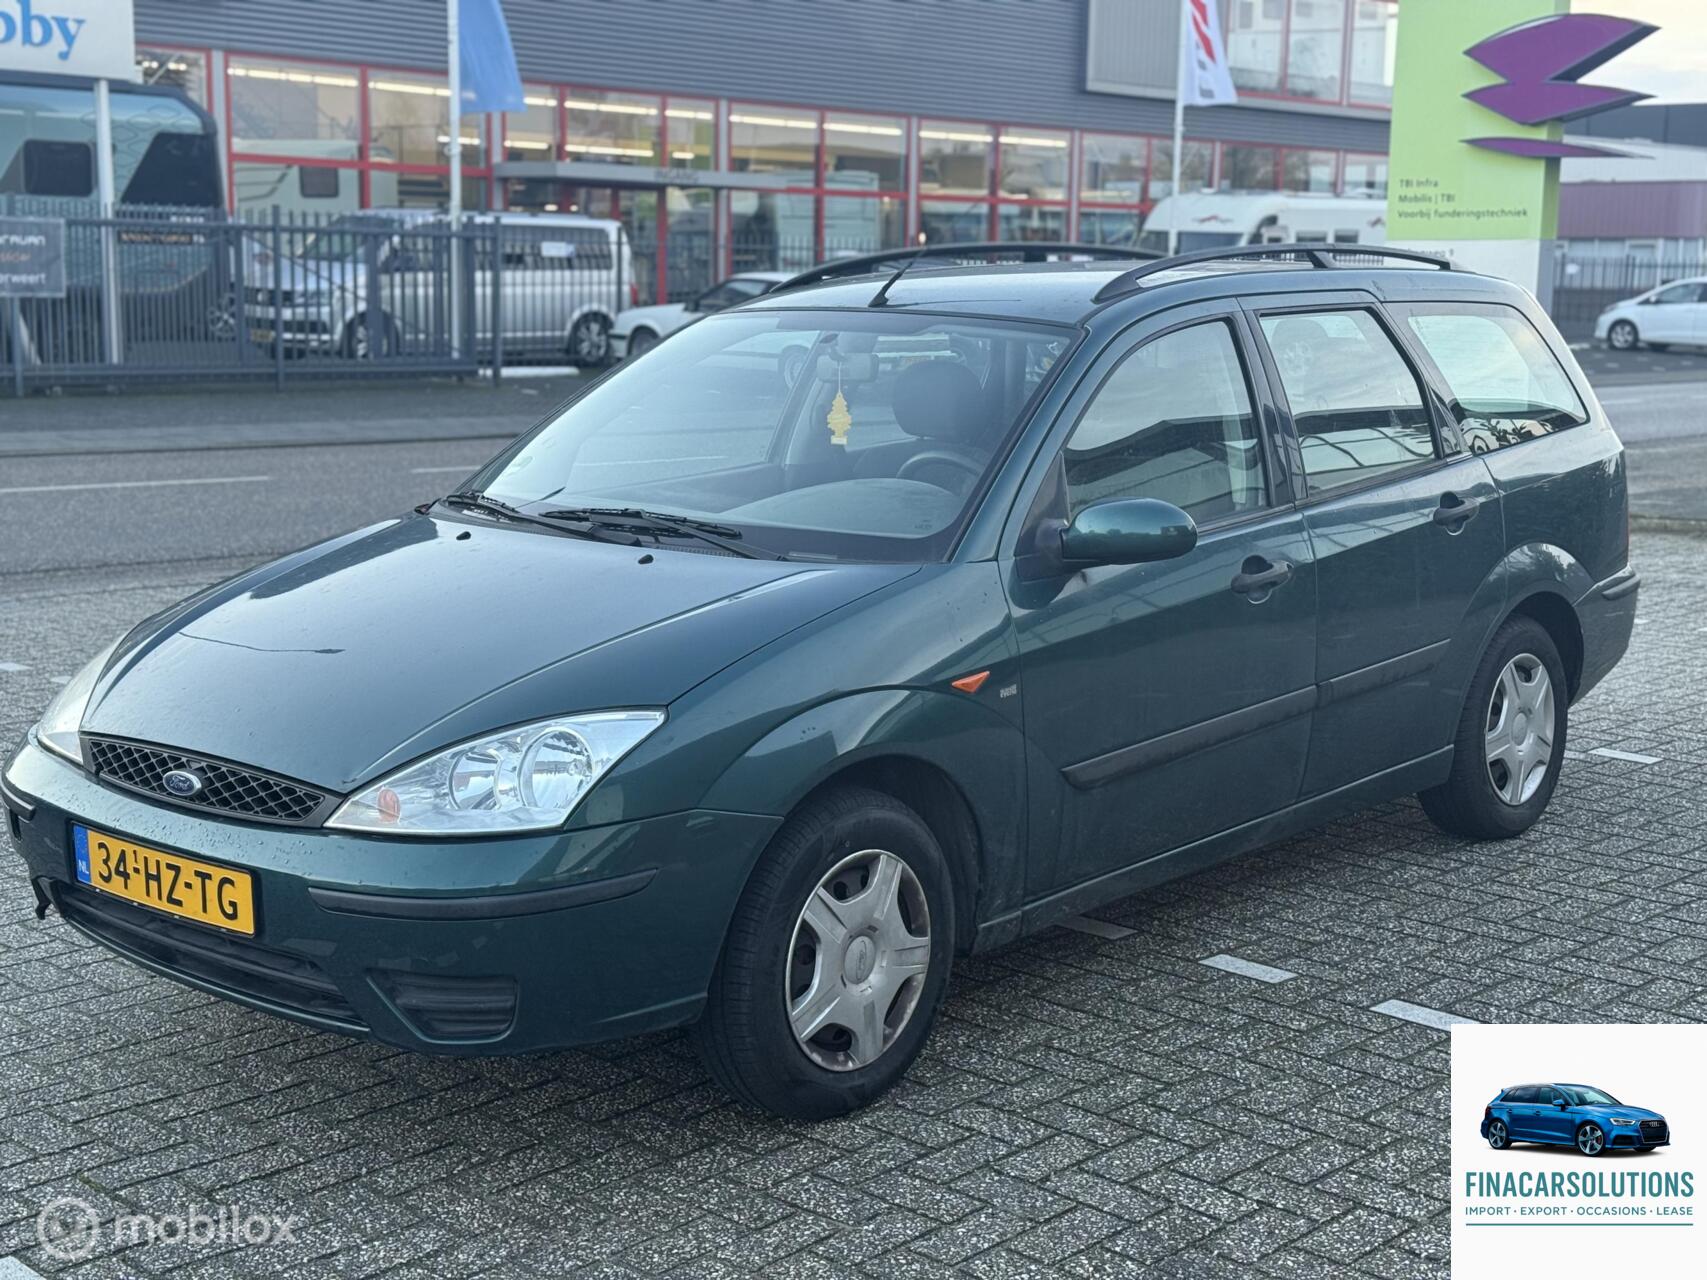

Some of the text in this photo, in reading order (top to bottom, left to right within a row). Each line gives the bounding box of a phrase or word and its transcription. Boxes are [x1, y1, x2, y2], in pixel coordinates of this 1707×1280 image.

[1399, 178, 1413, 188] TBI
[1441, 193, 1455, 203] TBI
[1397, 207, 1528, 220] Voorbij funderingstechniek
[78, 841, 239, 921] NL 34-HZ-TG
